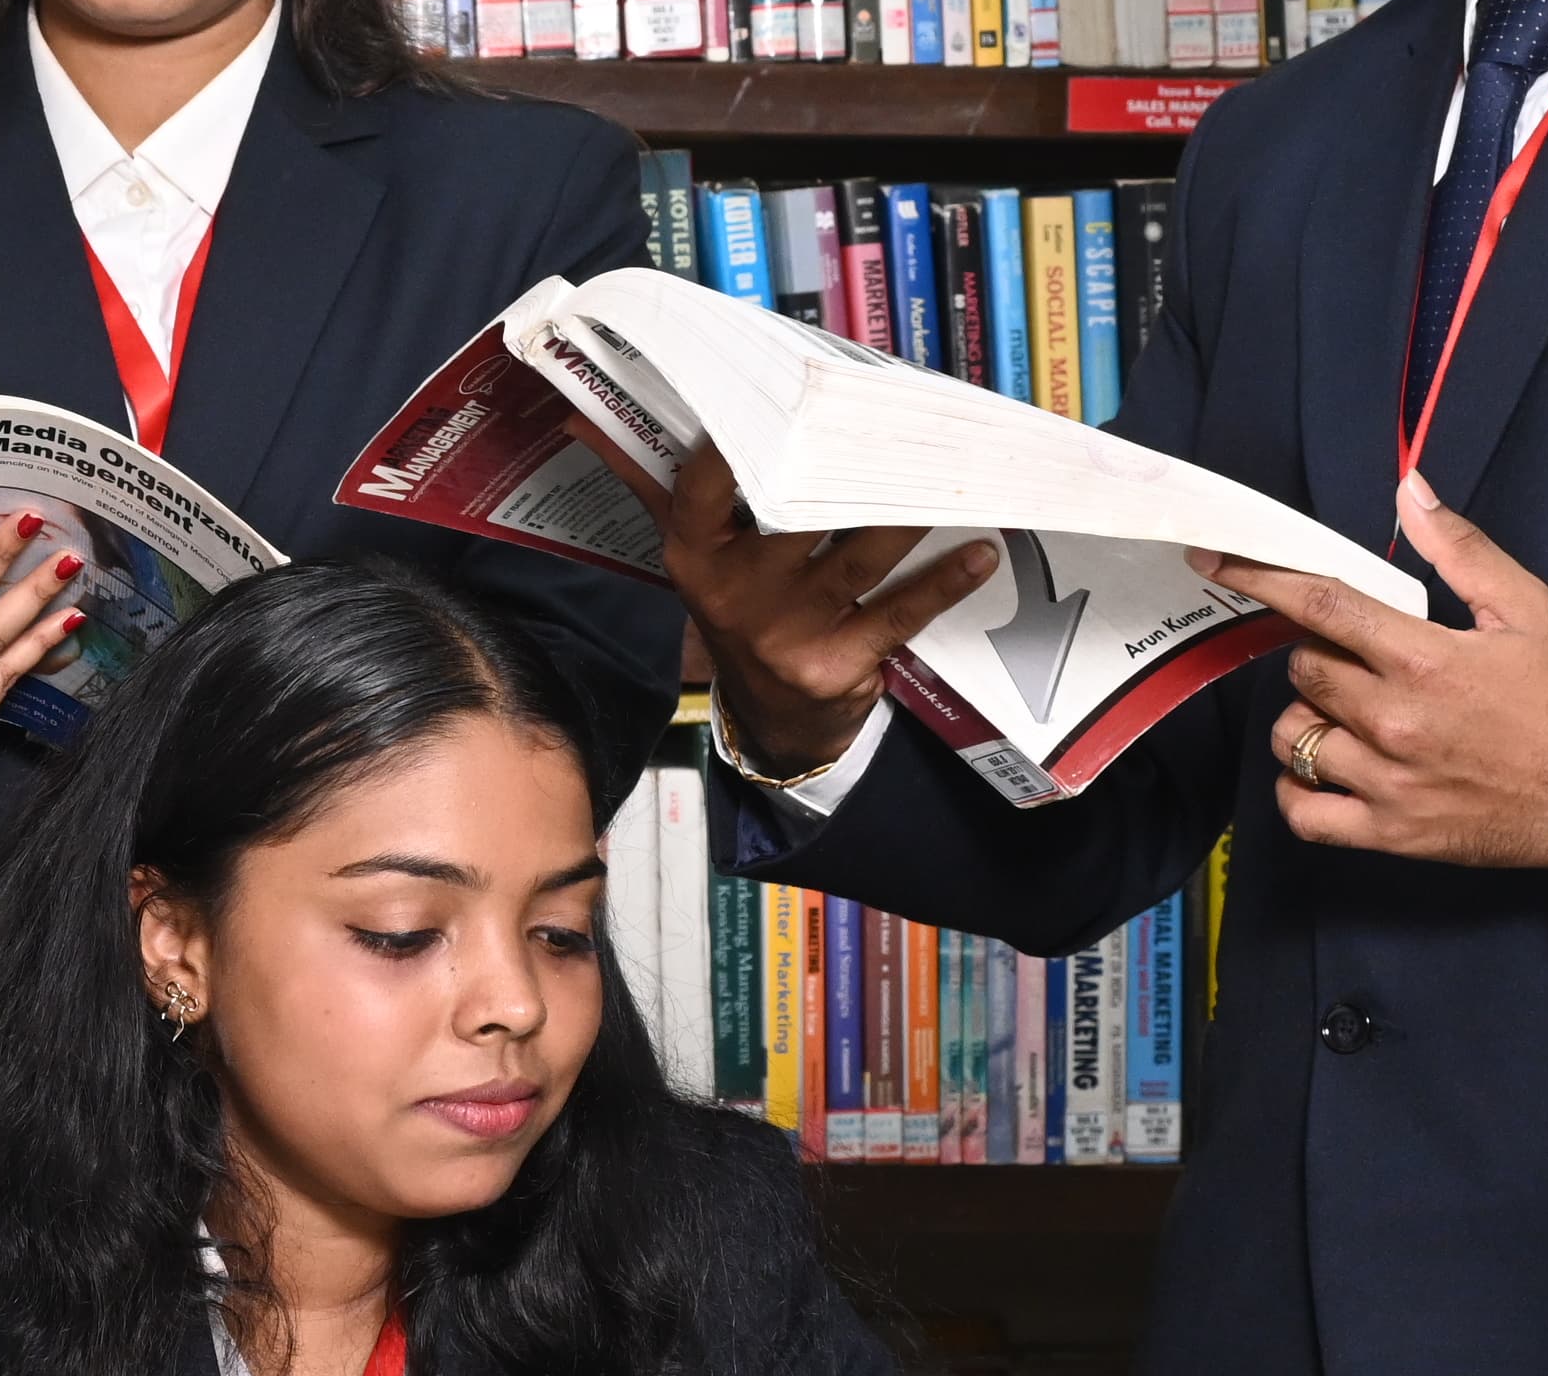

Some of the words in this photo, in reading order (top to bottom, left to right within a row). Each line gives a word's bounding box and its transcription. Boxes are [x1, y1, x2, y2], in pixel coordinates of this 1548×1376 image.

[669, 189, 689, 268] KOTLER
[1084, 221, 1117, 327] C-SCAPE
[357, 400, 491, 501] MANAGEMENT
[95, 499, 139, 527] SECOND
[141, 526, 181, 557] EDITION
[99, 446, 267, 573] Organizatio
[1124, 625, 1168, 660] Arun
[1162, 602, 1217, 633] Kumar
[884, 654, 961, 722] Meenakshi
